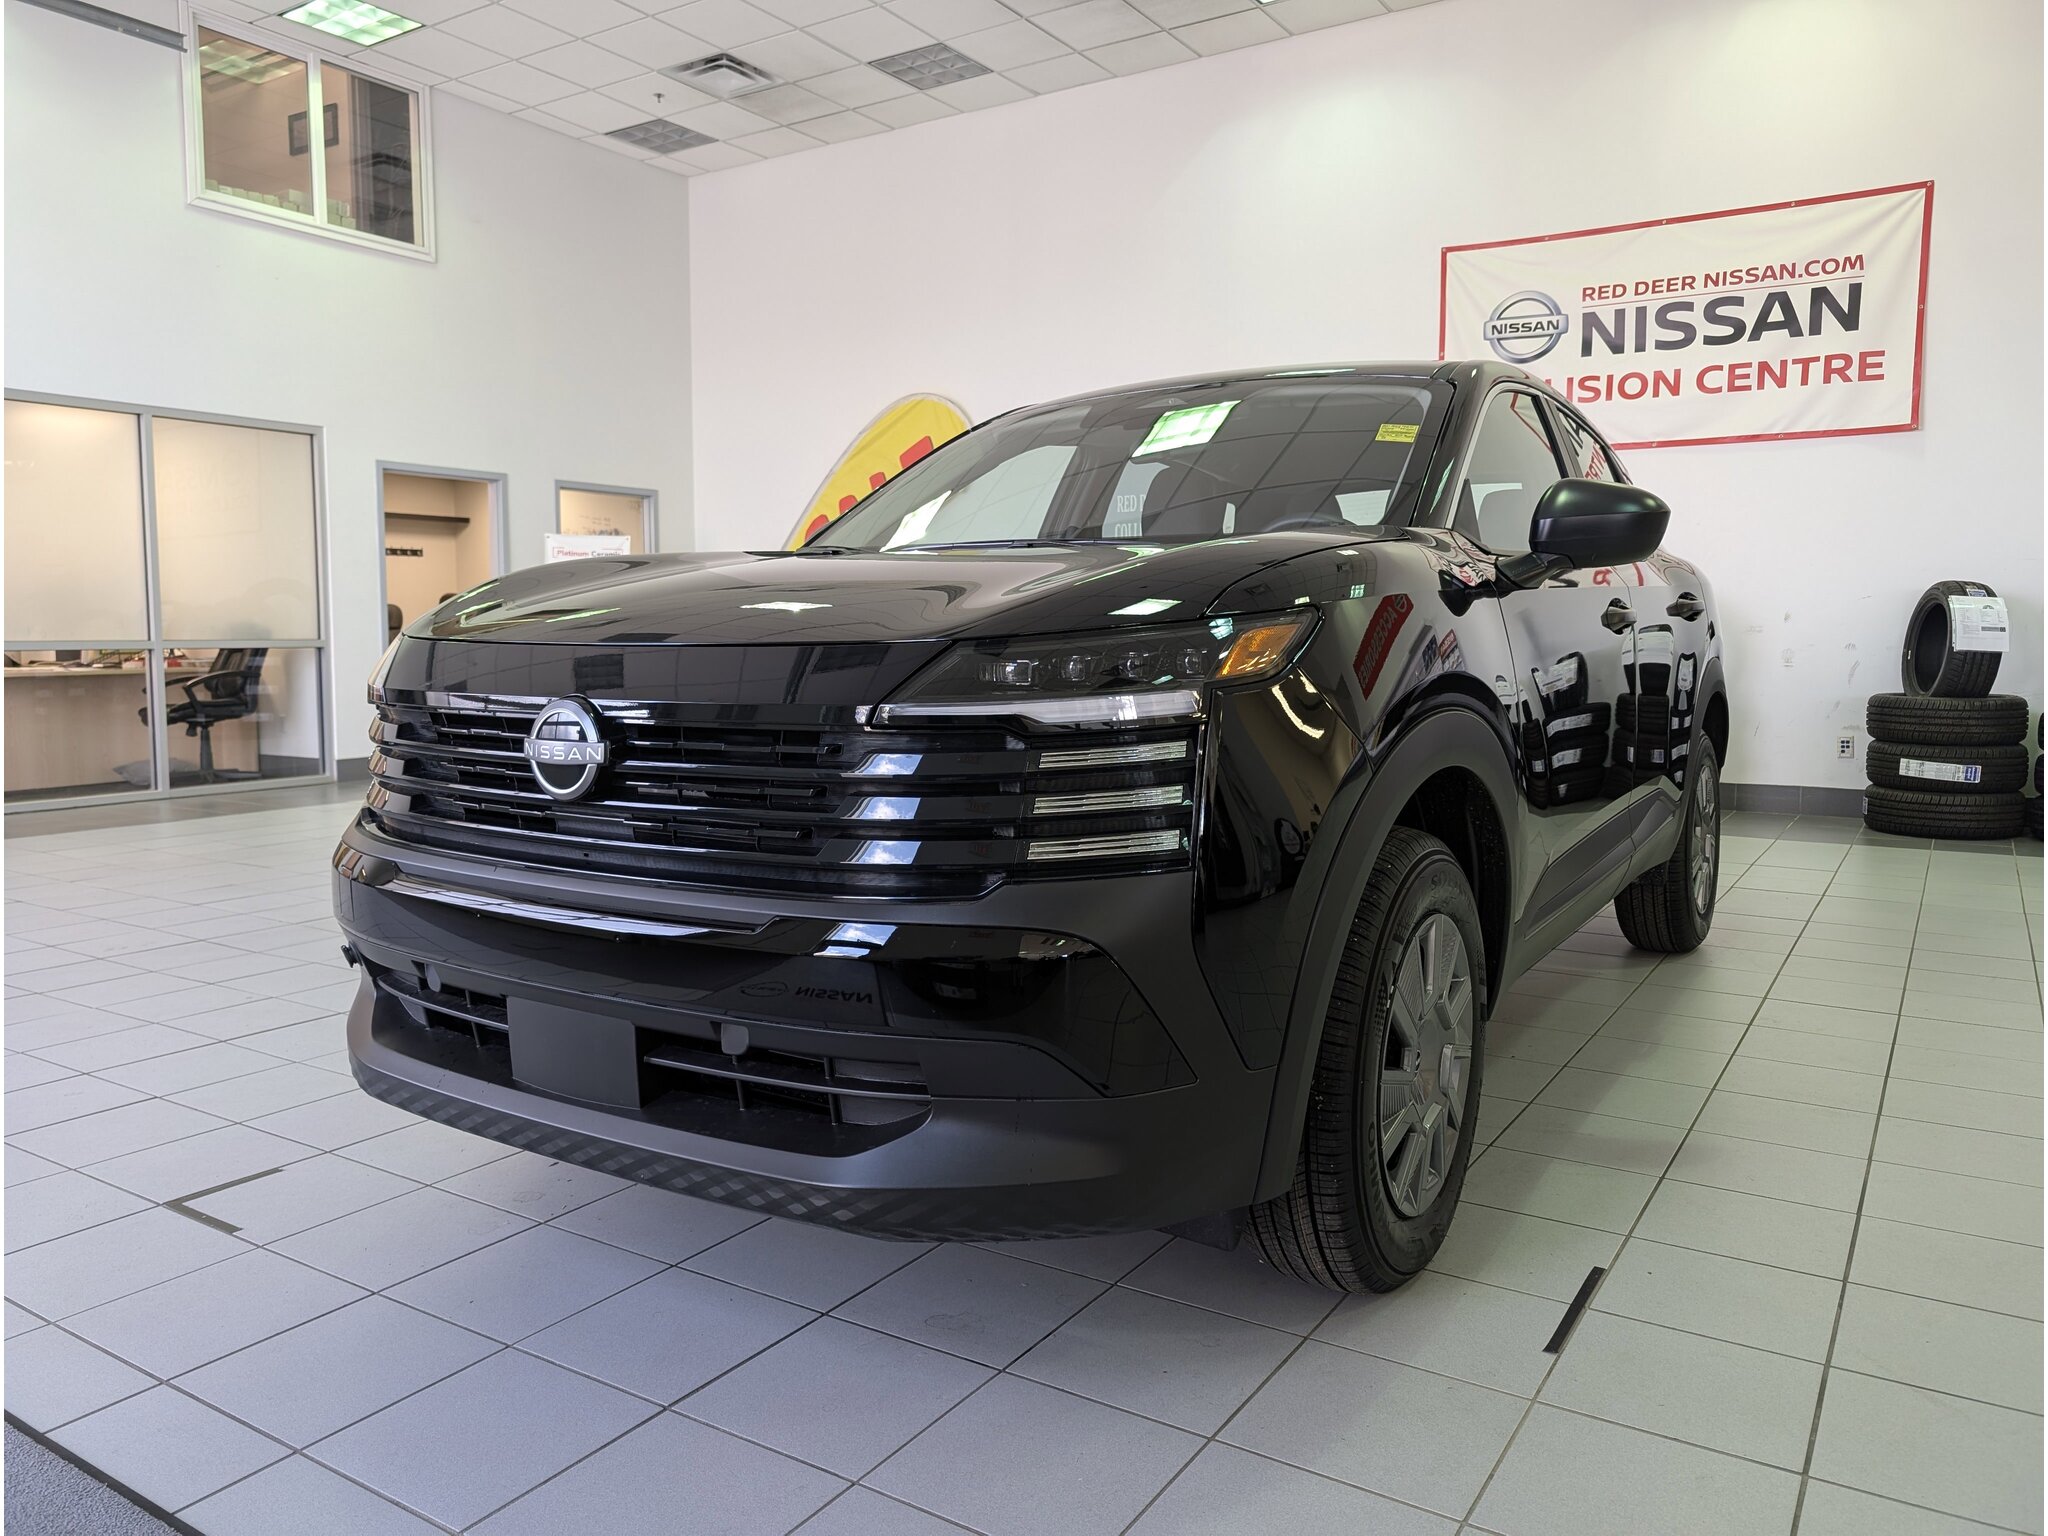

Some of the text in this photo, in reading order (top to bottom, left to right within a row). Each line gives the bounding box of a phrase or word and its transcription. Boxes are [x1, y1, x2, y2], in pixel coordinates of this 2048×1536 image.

[1582, 254, 1865, 302] RED DEER NISSAN.COM
[1491, 319, 1560, 336] NISSAN
[1581, 282, 1863, 358] NISSAN
[1544, 349, 1886, 404] ISION CENTRE
[1116, 494, 1137, 513] RED
[556, 549, 590, 557] Platinum
[524, 741, 602, 761] NISSAN
